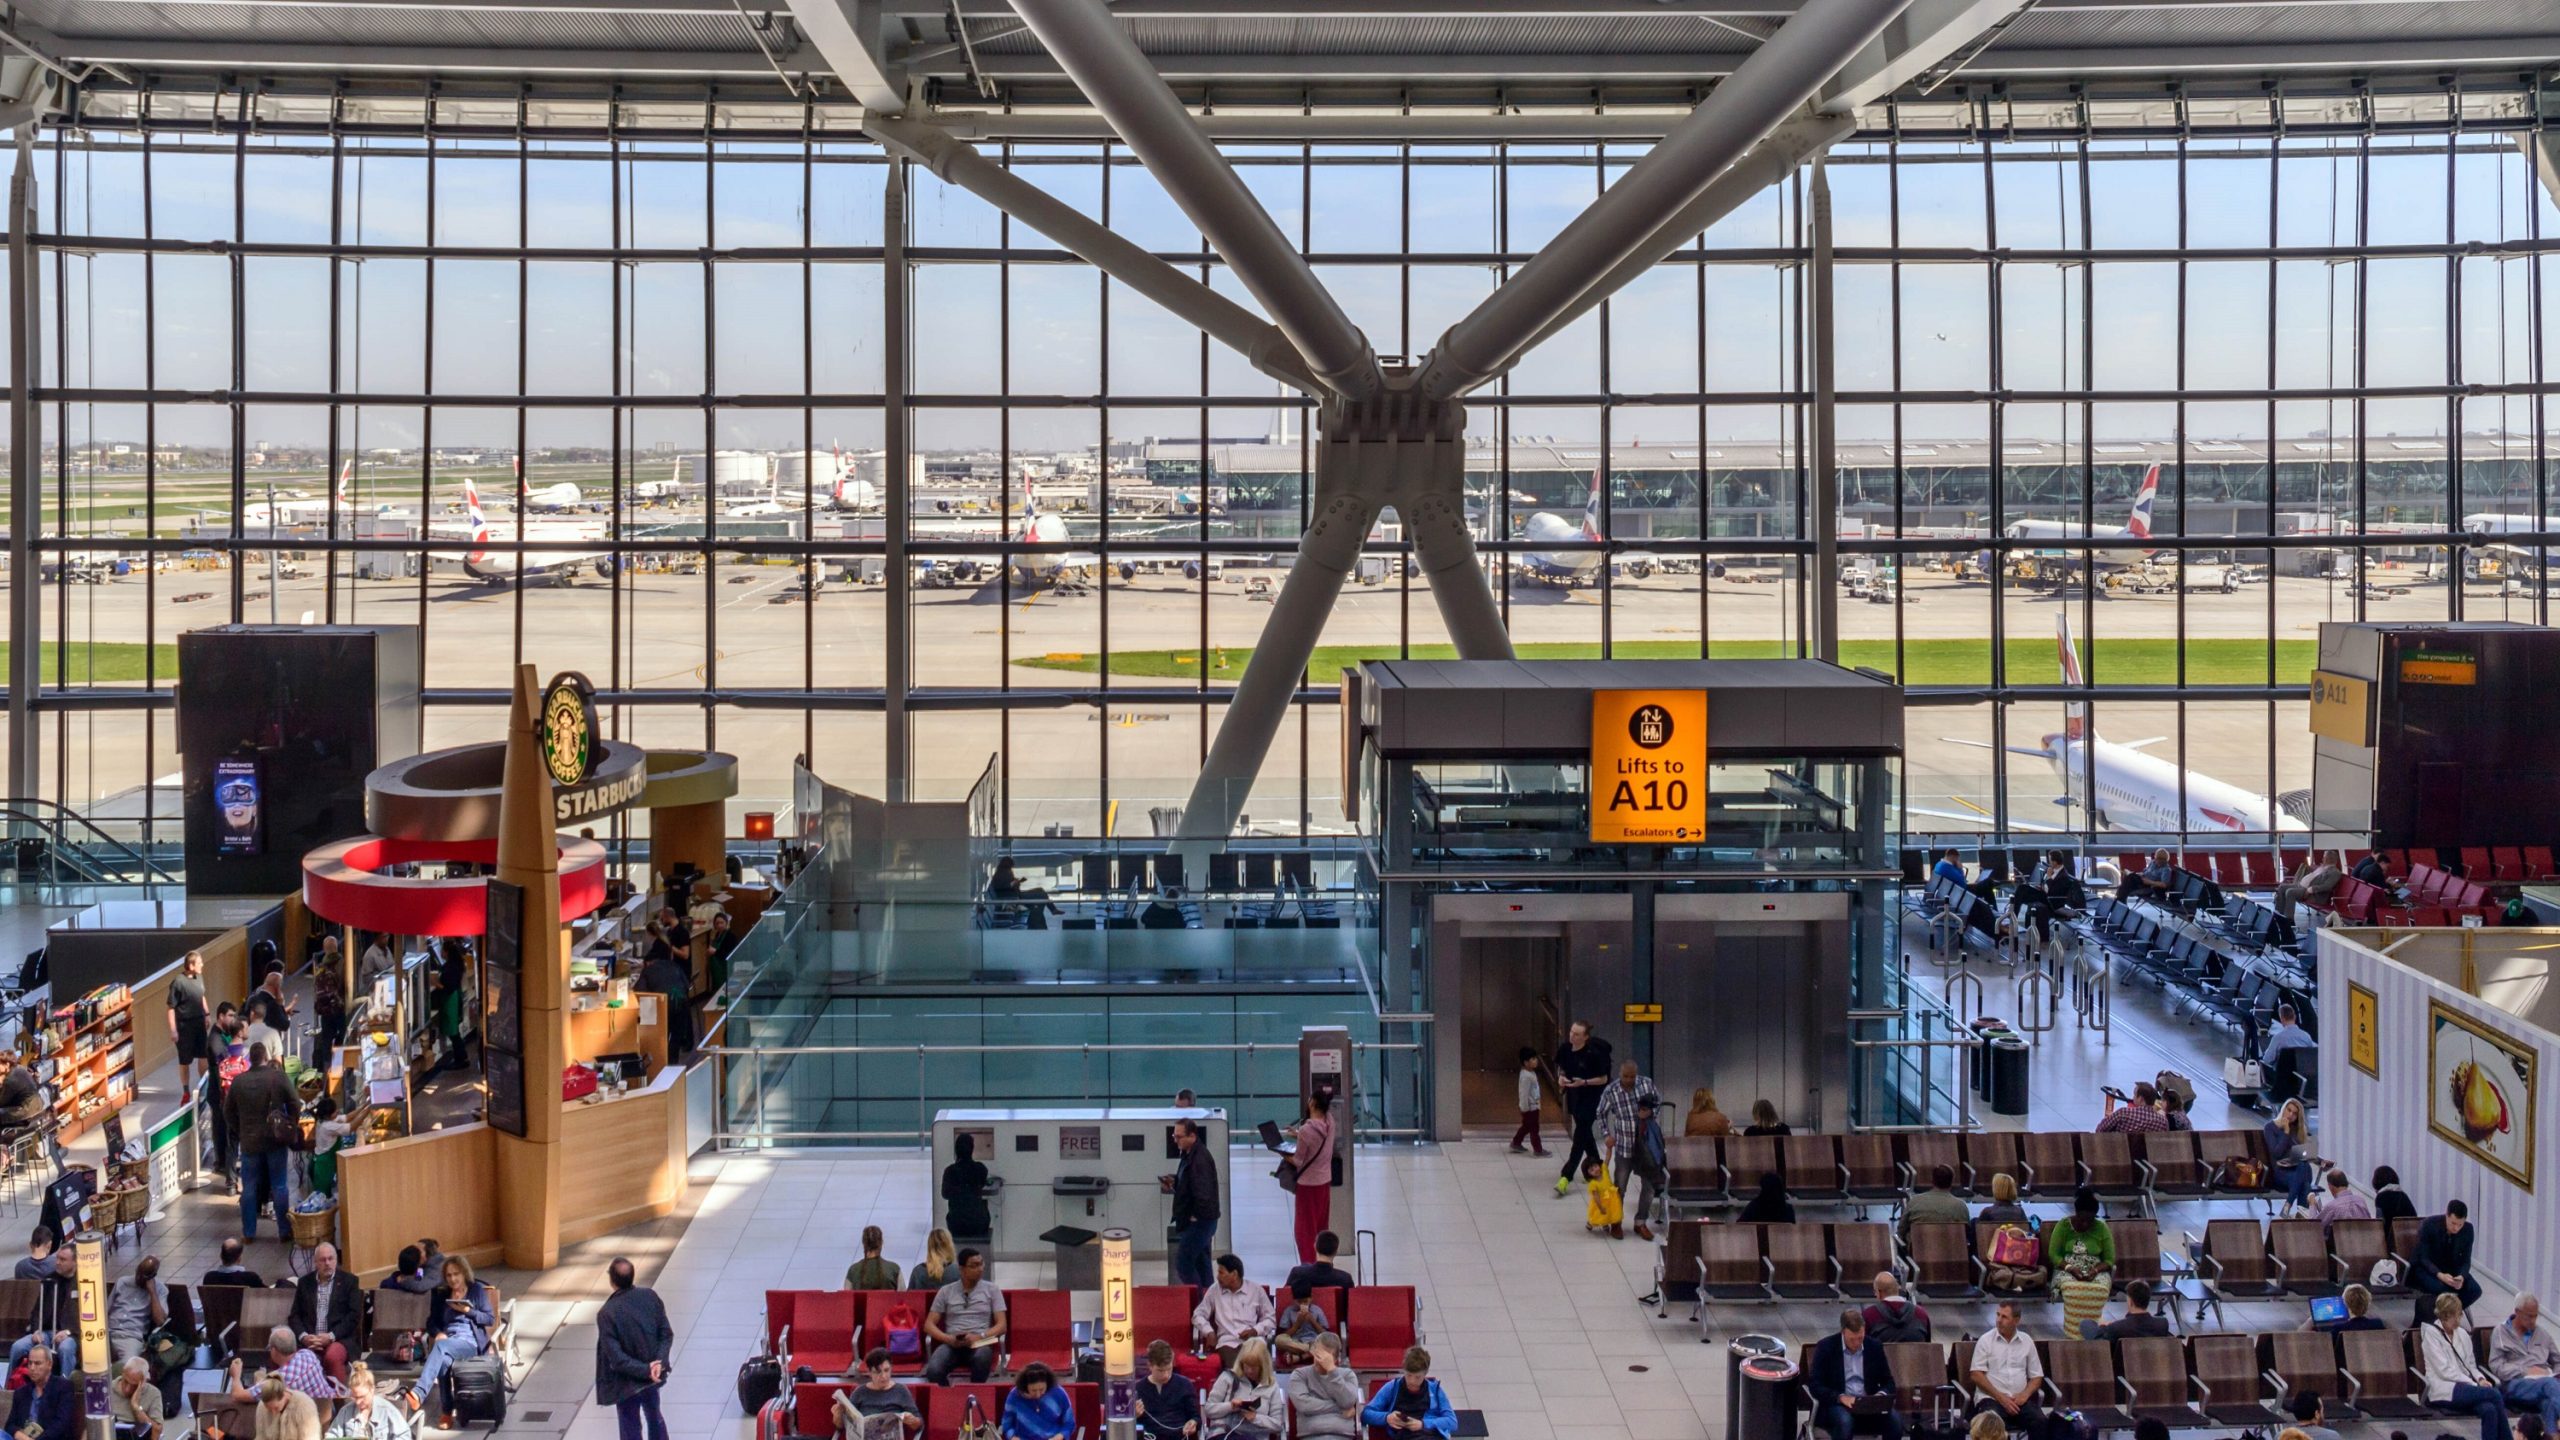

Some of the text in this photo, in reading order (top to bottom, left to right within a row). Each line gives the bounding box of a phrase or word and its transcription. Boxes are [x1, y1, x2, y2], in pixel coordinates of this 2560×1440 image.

[2327, 683, 2347, 705] A11
[547, 691, 587, 734] STARBUCKS
[551, 754, 583, 781] COFFEE
[1617, 758, 1684, 774] Lifts to
[1609, 779, 1688, 811] A10
[1624, 827, 1674, 837] Escalators
[1061, 1137, 1099, 1150] FREE
[77, 1251, 100, 1263] harge
